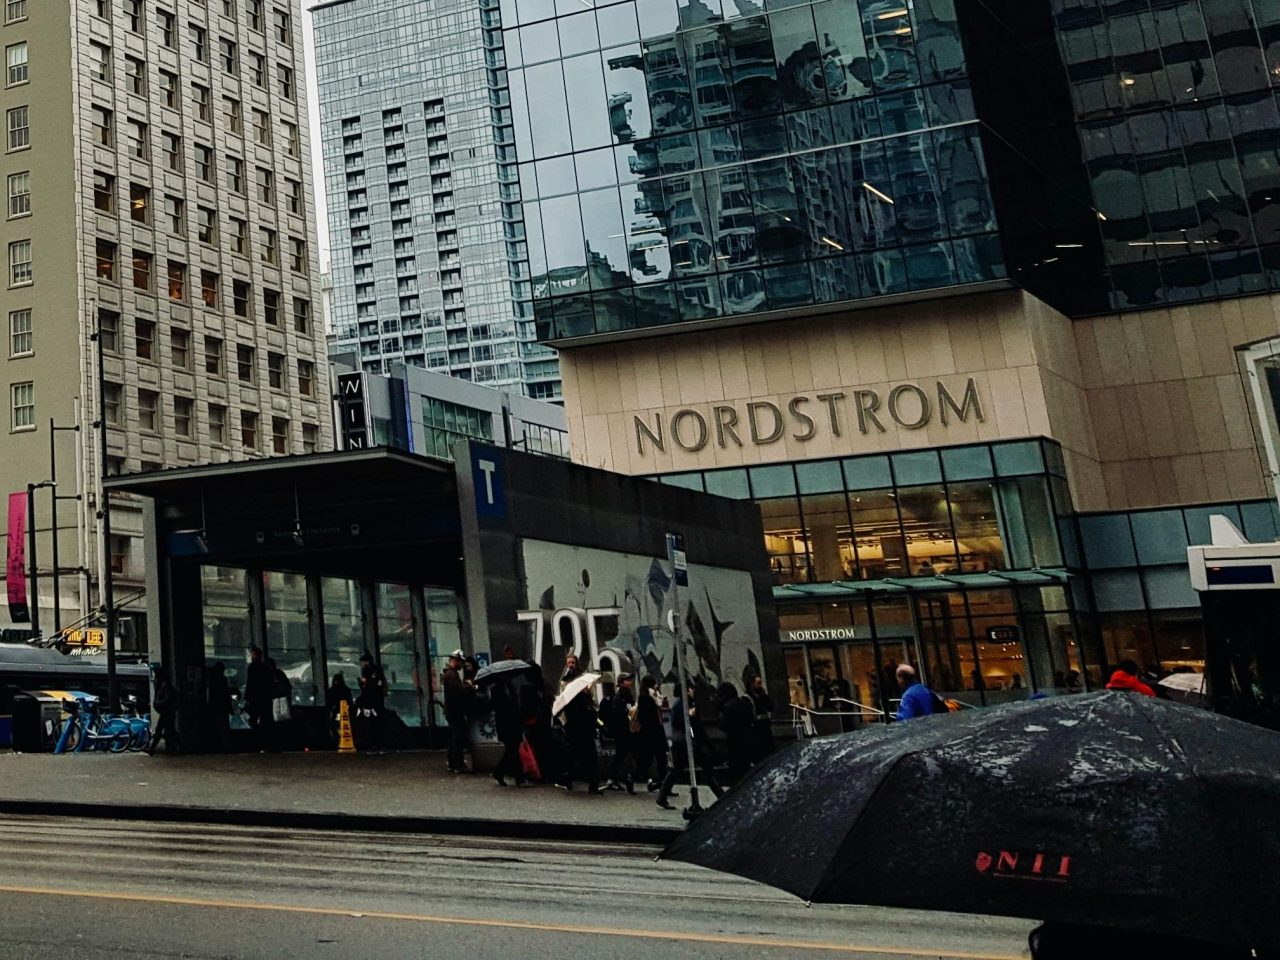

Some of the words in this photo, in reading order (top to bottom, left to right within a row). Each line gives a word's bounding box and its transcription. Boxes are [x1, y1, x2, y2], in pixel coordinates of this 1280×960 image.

[634, 377, 984, 456] NORDSTROM
[478, 459, 495, 505] T
[789, 628, 855, 641] NORDSTROM
